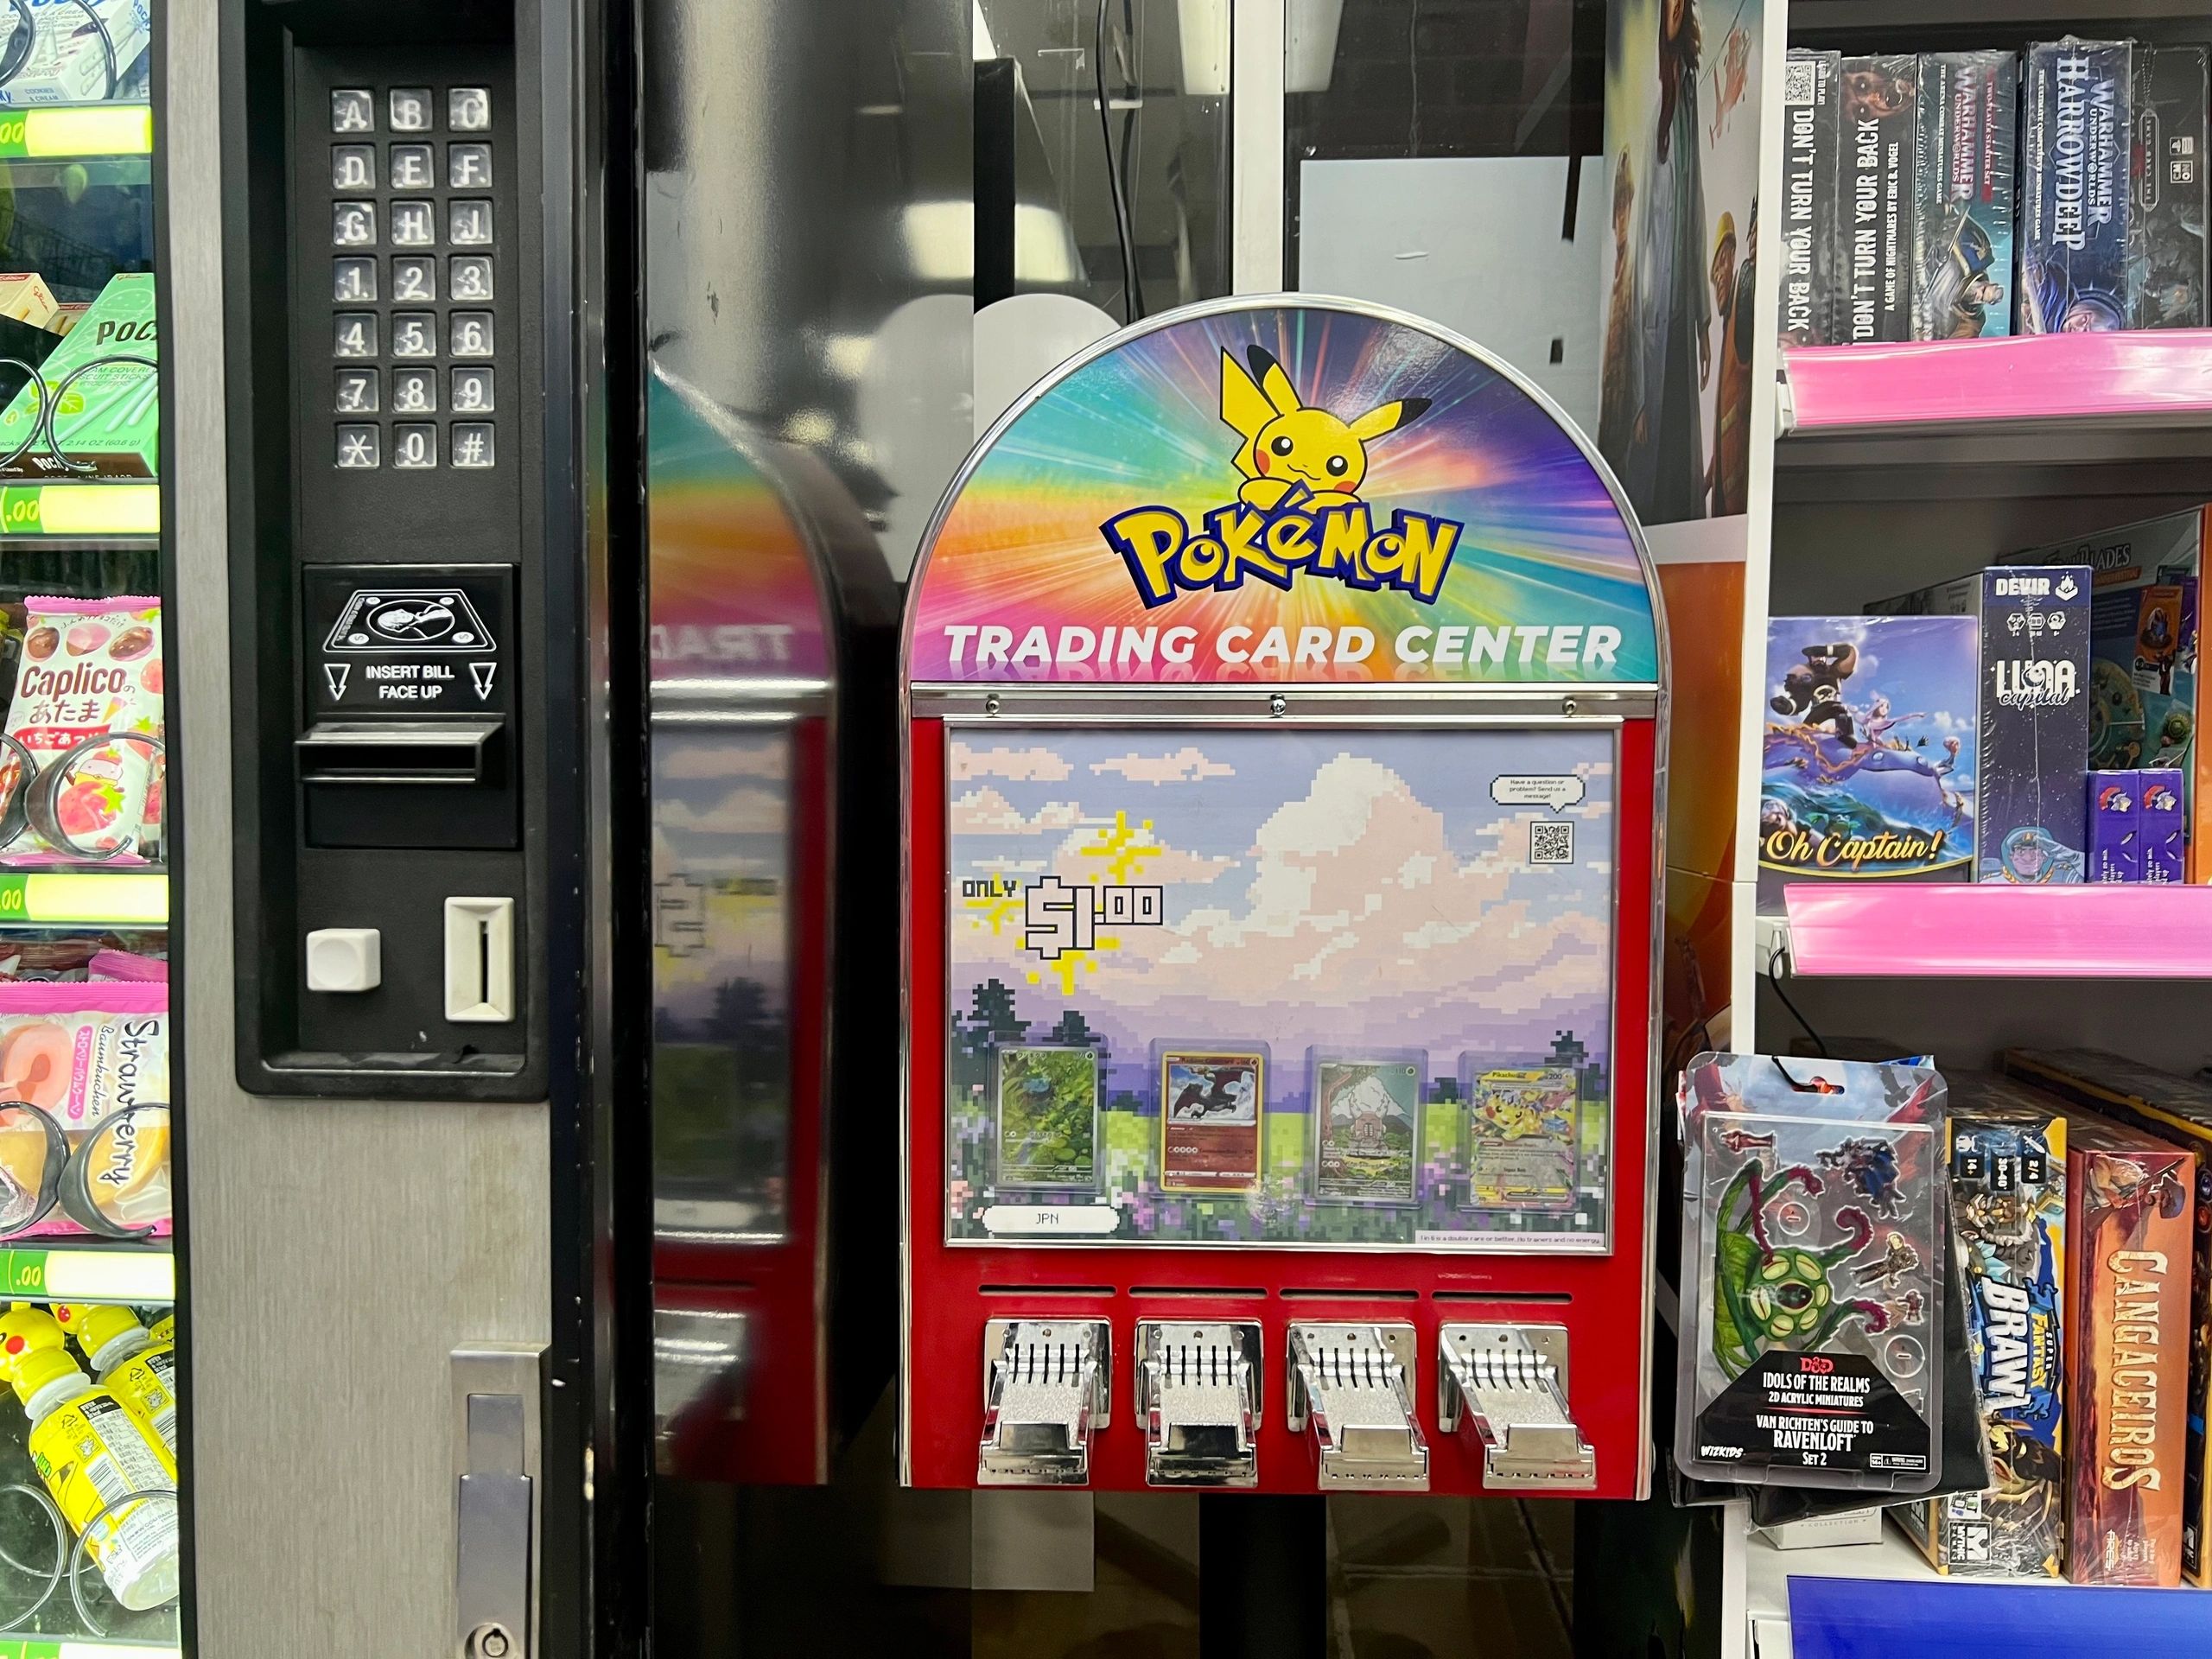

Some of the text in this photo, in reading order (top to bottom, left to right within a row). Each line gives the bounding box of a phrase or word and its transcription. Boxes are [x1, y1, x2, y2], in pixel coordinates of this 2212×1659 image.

[345, 99, 480, 127] A B C
[1950, 66, 1978, 203] WARHAMMER
[1952, 93, 1962, 182] UNDERWORLDS
[1889, 143, 1899, 168] VOGEL
[1936, 137, 1945, 181] MINIATURES
[2052, 57, 2089, 251] HARROWDEEP
[2087, 79, 2115, 226] WARHAMMER
[2087, 108, 2098, 205] UNDERWORLDS
[346, 156, 480, 183] D E F
[1888, 181, 1897, 200] ERIC
[2035, 173, 2044, 218] MINIATURES
[1787, 108, 1817, 332] DON'T TURN YOUR BACK
[1887, 200, 1897, 212] BY
[346, 213, 365, 239] G
[404, 213, 423, 237] H
[1851, 118, 1880, 340] DON'T TURN YOUR BACK
[1886, 213, 1897, 265] NIGHTMARES
[405, 267, 423, 296] 2
[462, 266, 481, 295] 3
[1886, 267, 1896, 278] OF
[1885, 280, 1896, 303] GAME
[347, 321, 482, 350] 4 5 6
[349, 378, 483, 406] 7 8 9
[407, 433, 424, 462] 0
[464, 433, 484, 461] #
[6, 500, 39, 522] .00
[1995, 577, 2050, 596] DEVIR
[944, 626, 1622, 664] TRADING CARD CENTER
[21, 662, 127, 702] Caplico
[365, 665, 454, 679] INSERT BILL
[1996, 660, 2075, 698] LUNA
[379, 685, 442, 699] FACE UP
[1999, 689, 2070, 710] capital
[29, 699, 100, 724] あたま
[1766, 830, 1944, 872] Oh Captain!
[963, 876, 1163, 960] ONLY $1.00
[92, 1026, 114, 1117] Baumkuchen
[99, 1020, 161, 1185] Strawerry
[1967, 1159, 1977, 1175] 14+
[2028, 1160, 2038, 1179] 2/4
[1036, 1213, 1058, 1224] JPN
[16, 1266, 41, 1287] .00
[1980, 1276, 2031, 1414] BRAWL
[2031, 1313, 2049, 1388] FANTASY
[2045, 1332, 2054, 1370] SUPER
[1800, 1357, 1834, 1374] D&D
[2101, 1250, 2168, 1492] CANGACEIROS
[1763, 1372, 1870, 1394] IDOLS OF THE REALMS
[1769, 1391, 1864, 1408] 2D ACRYLIC MINIATURES
[1757, 1414, 1874, 1434] VAN RICHTEN'S GUIDE TO
[1701, 1446, 1744, 1459] WIZKIDS
[1773, 1430, 1853, 1452] RAVENLOFT
[1821, 1452, 1827, 1465] 2
[1957, 1525, 1966, 1560] MYTHIC
[2105, 1529, 2115, 1571] ARES
